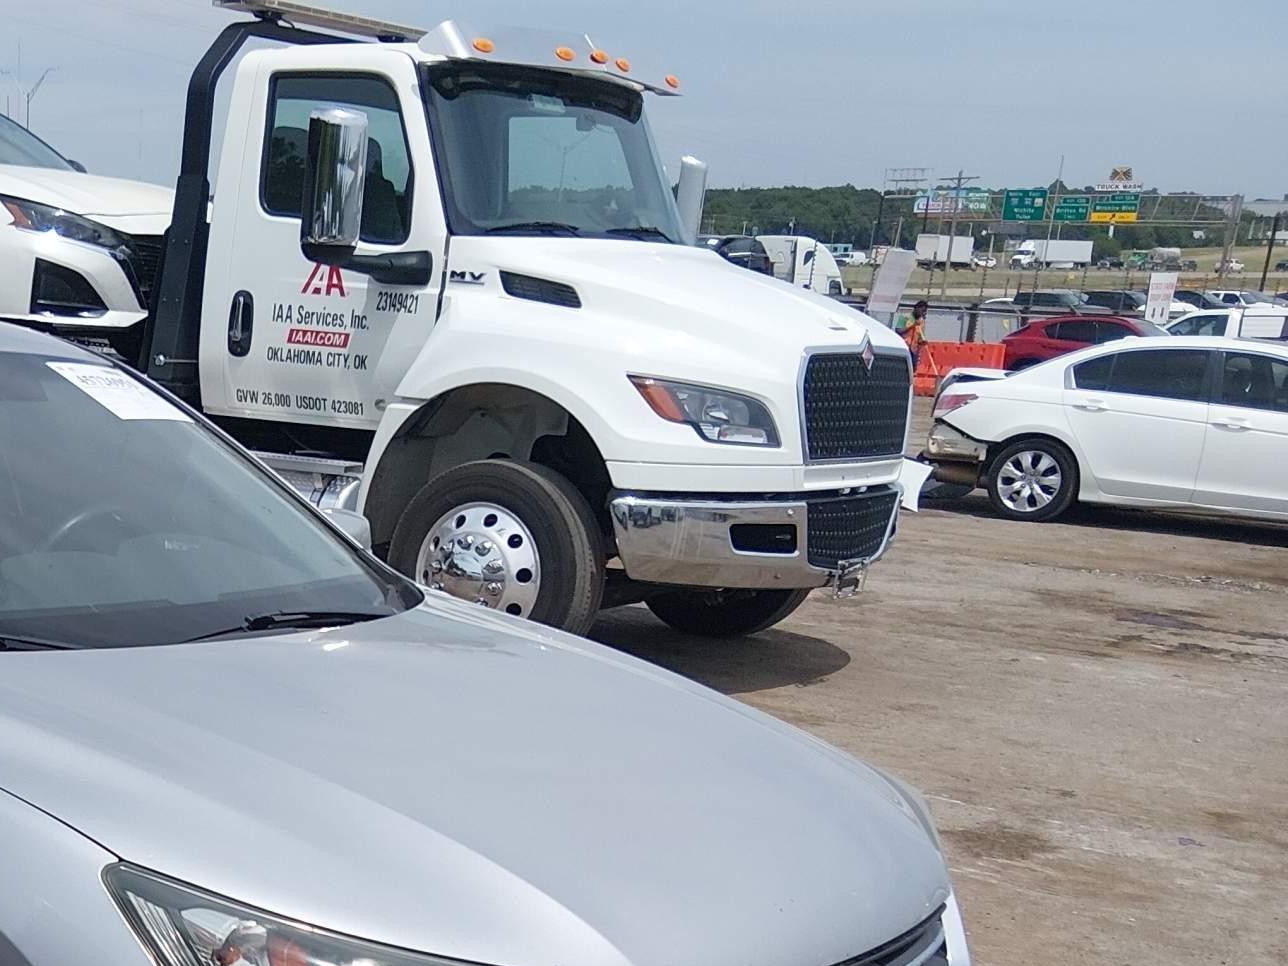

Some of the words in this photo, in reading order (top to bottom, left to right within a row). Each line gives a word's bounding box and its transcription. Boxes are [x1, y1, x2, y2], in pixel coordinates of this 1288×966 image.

[450, 269, 487, 281] MV
[376, 291, 420, 315] 23149421
[272, 303, 293, 324] IAA
[297, 306, 349, 330] Services,
[350, 309, 370, 330] Inc.
[291, 330, 346, 347] IAAI.COM
[267, 346, 323, 367] OKLAHOMA
[326, 352, 350, 370] CITY,
[353, 354, 368, 371] OK
[236, 388, 259, 404] GVW
[262, 391, 291, 408] 26,000
[296, 395, 328, 412] USDOT
[331, 398, 364, 416] 423081
